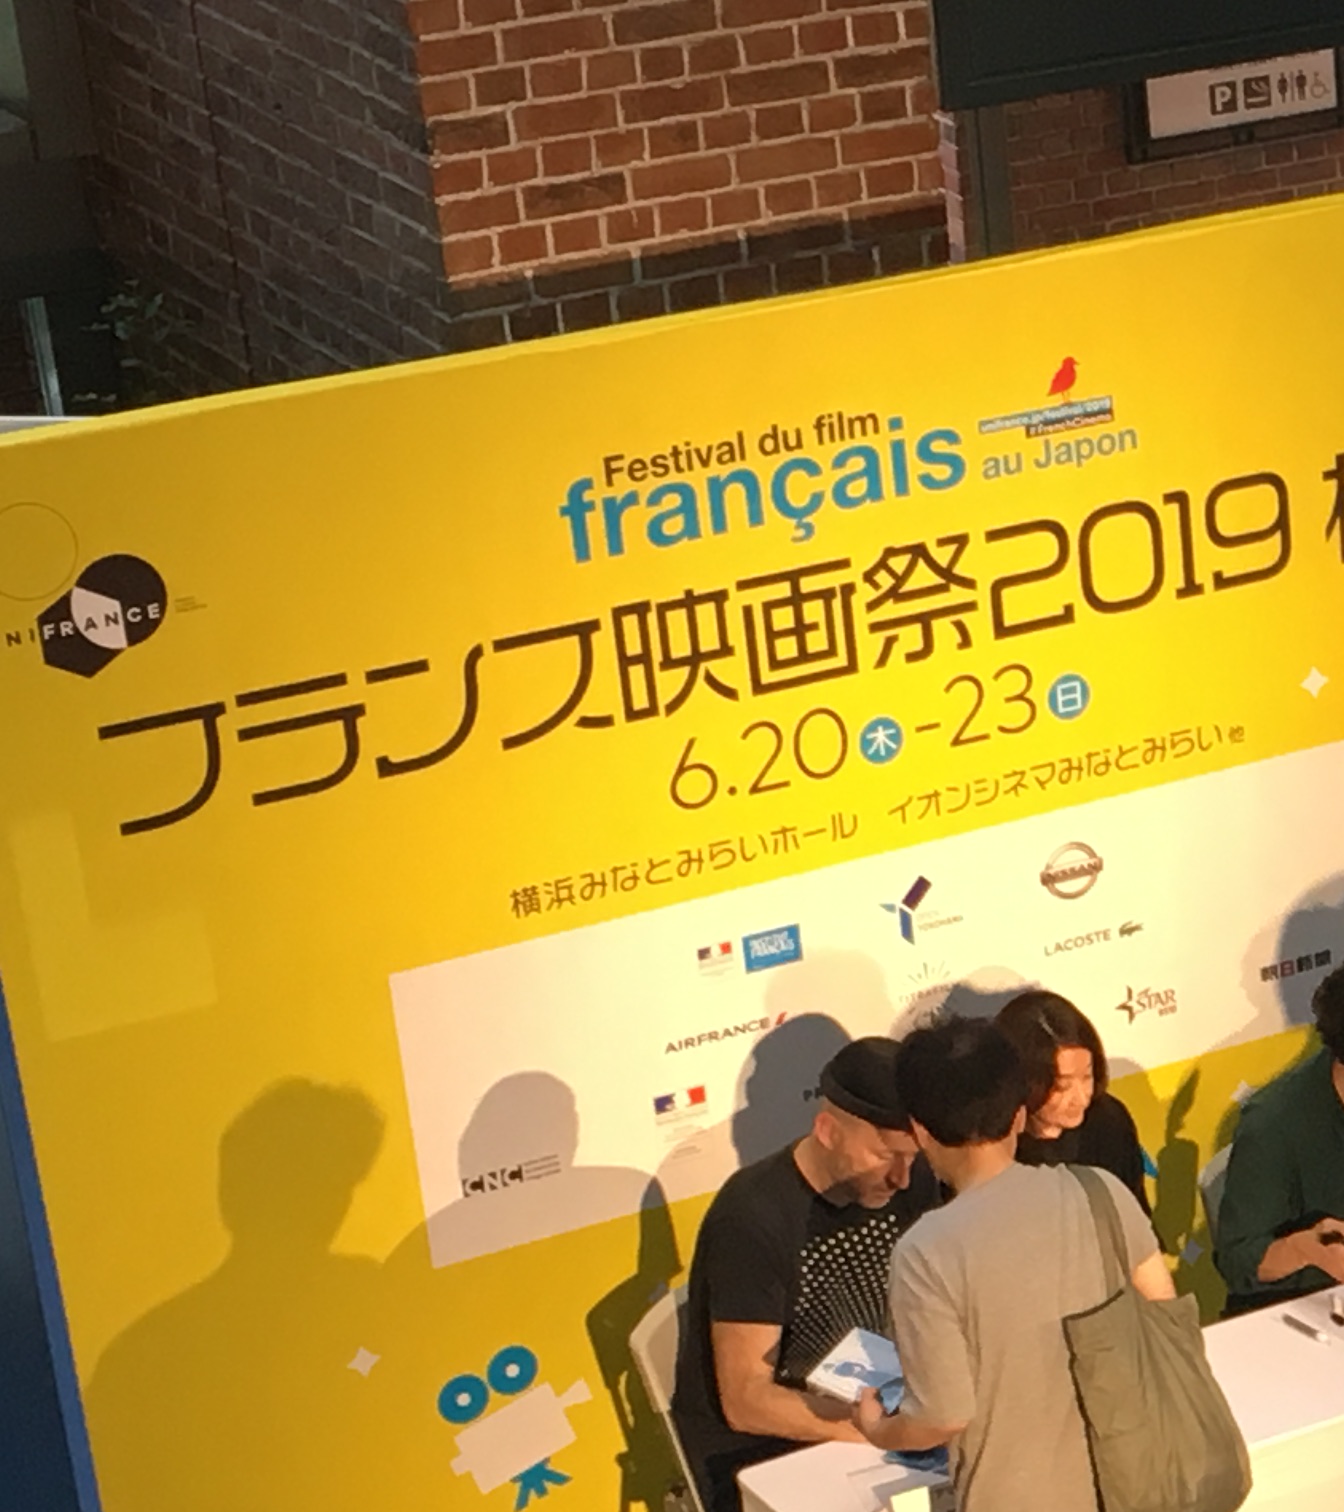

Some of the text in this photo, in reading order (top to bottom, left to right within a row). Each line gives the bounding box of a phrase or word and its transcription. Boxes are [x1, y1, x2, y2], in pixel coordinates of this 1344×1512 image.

[602, 411, 880, 488] Festival du film
[982, 428, 1138, 481] au Japon
[558, 417, 967, 563] français
[509, 812, 858, 919] 横浜みなとみらいホール
[1043, 928, 1112, 957] LACOSTE
[462, 1164, 524, 1198] CNC
